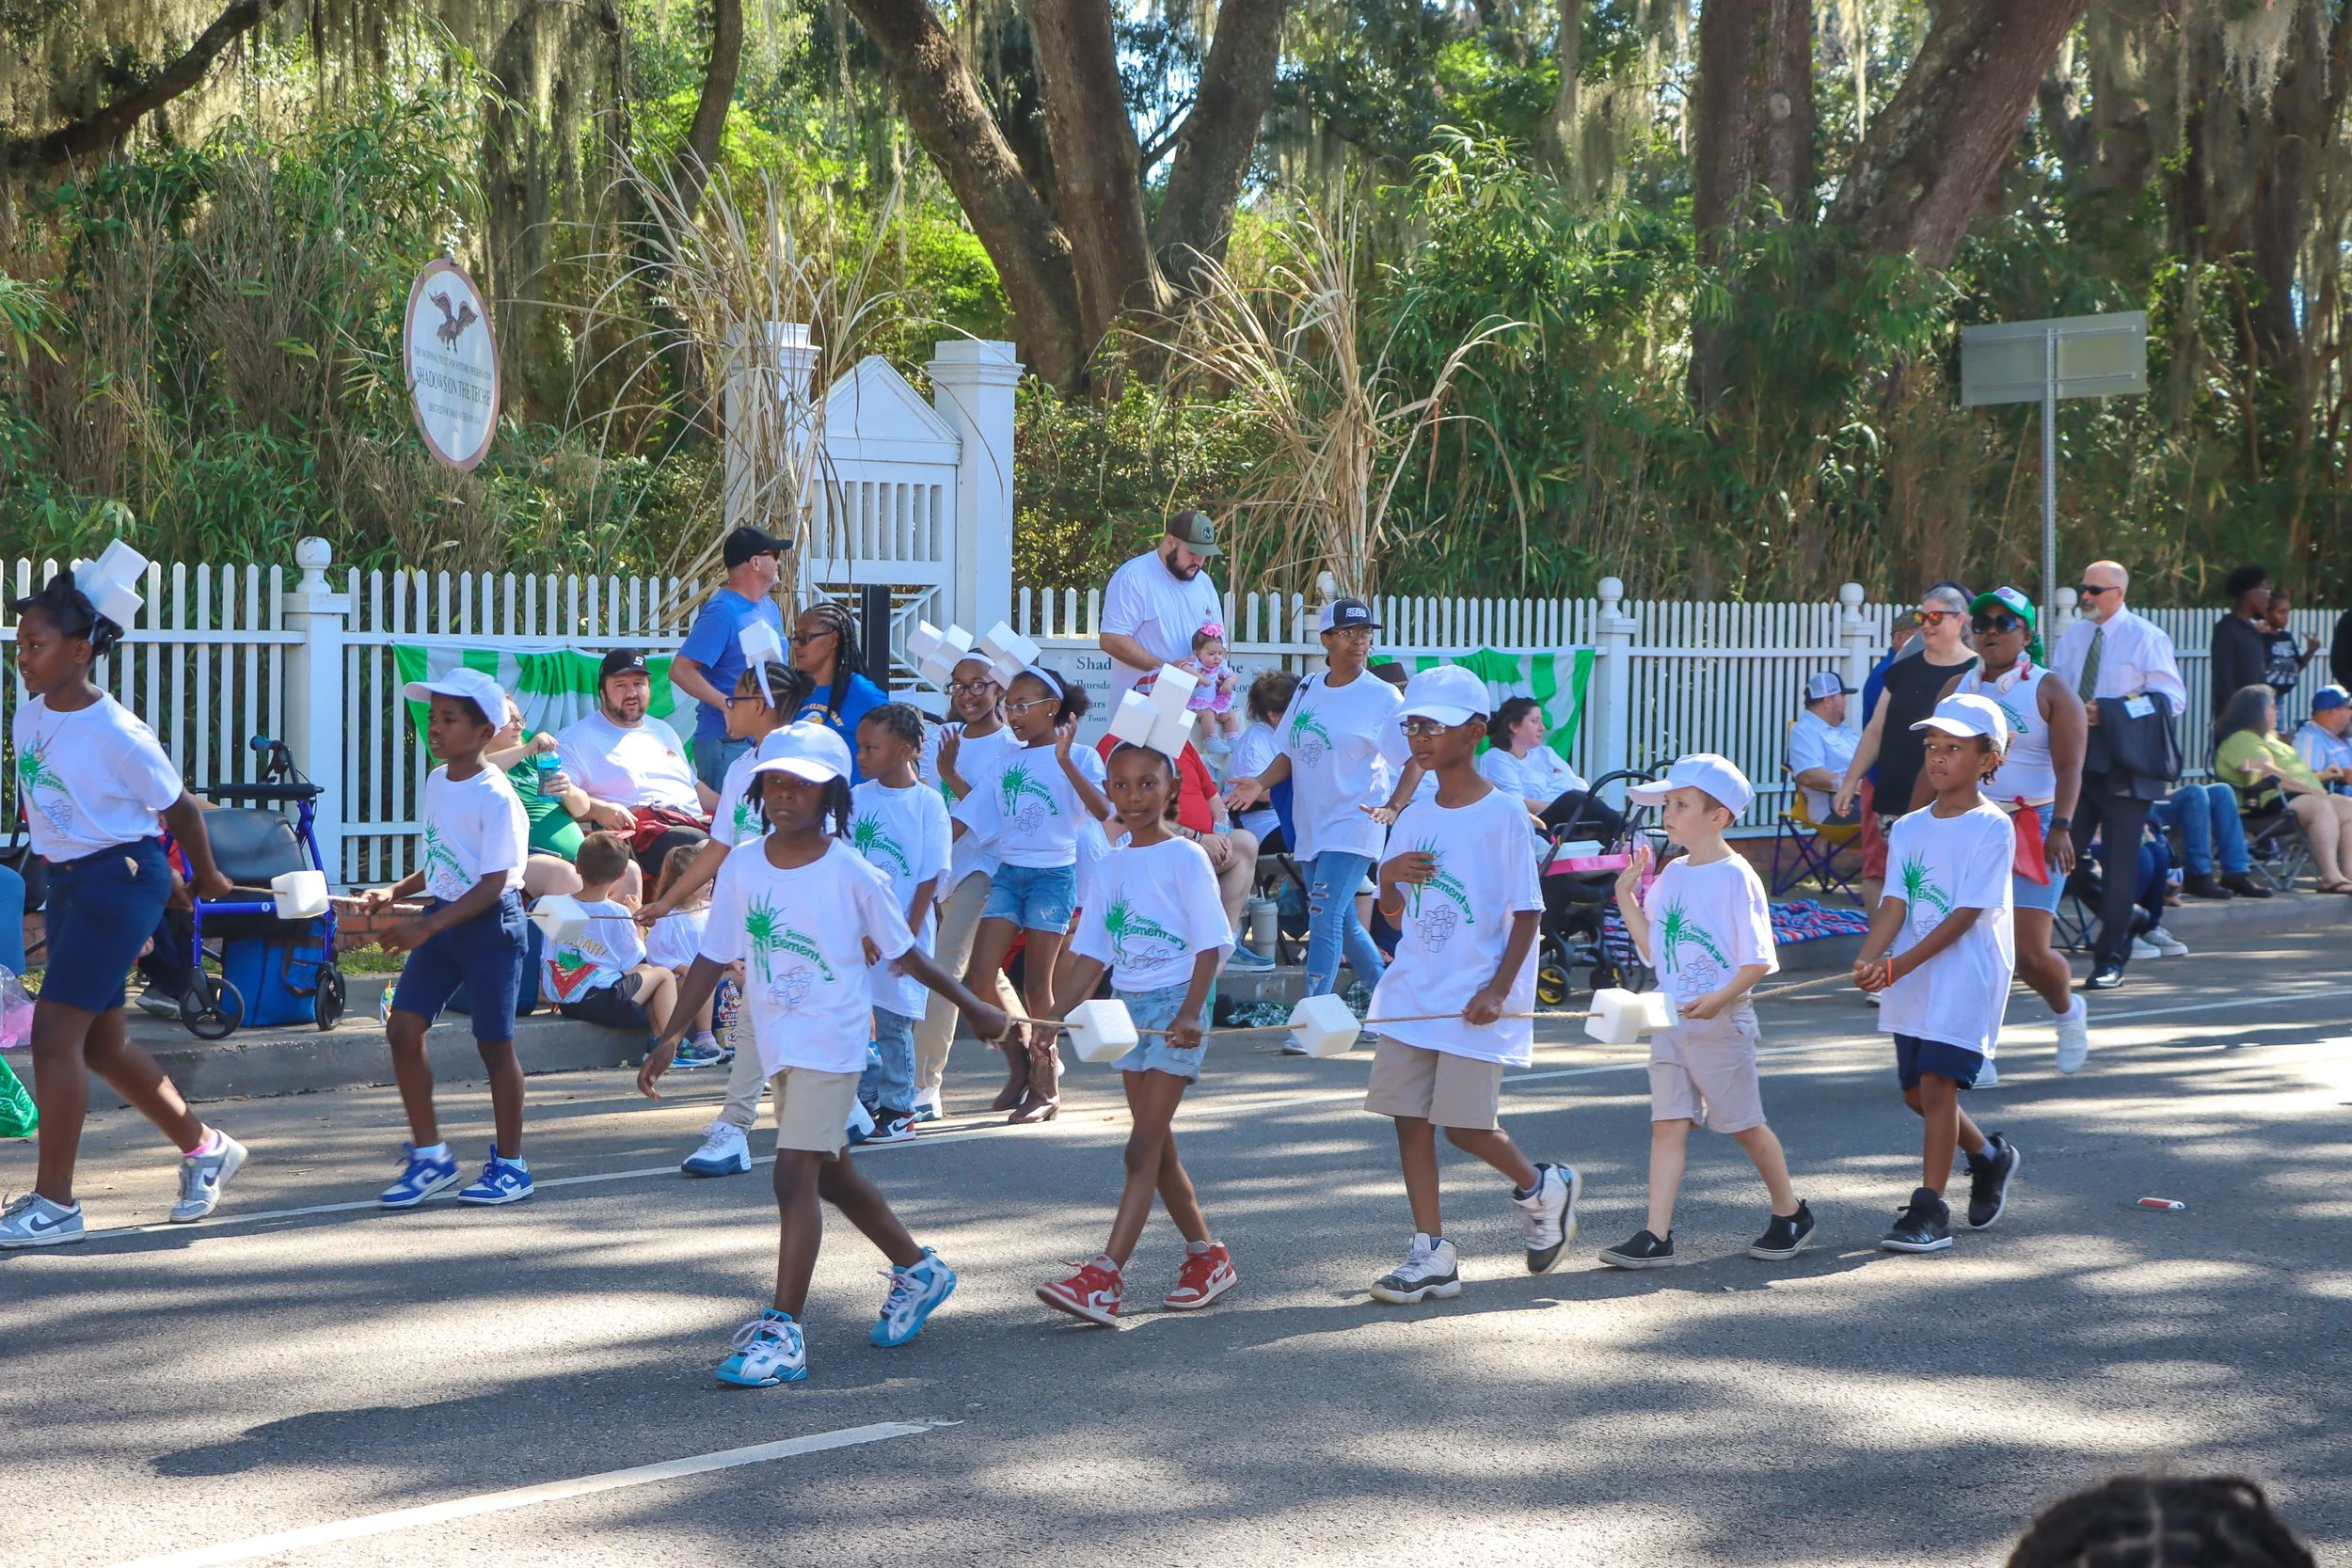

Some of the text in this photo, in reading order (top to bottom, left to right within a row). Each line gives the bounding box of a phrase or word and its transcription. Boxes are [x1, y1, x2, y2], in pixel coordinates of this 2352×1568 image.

[416, 366, 491, 406] SHADOWS ON THE TECHE
[1021, 784, 1059, 816] Elementary
[871, 839, 912, 877] Elementary
[1123, 923, 1187, 951] Elementary
[1678, 929, 1729, 969] Elementary
[771, 934, 835, 981] Elementary
